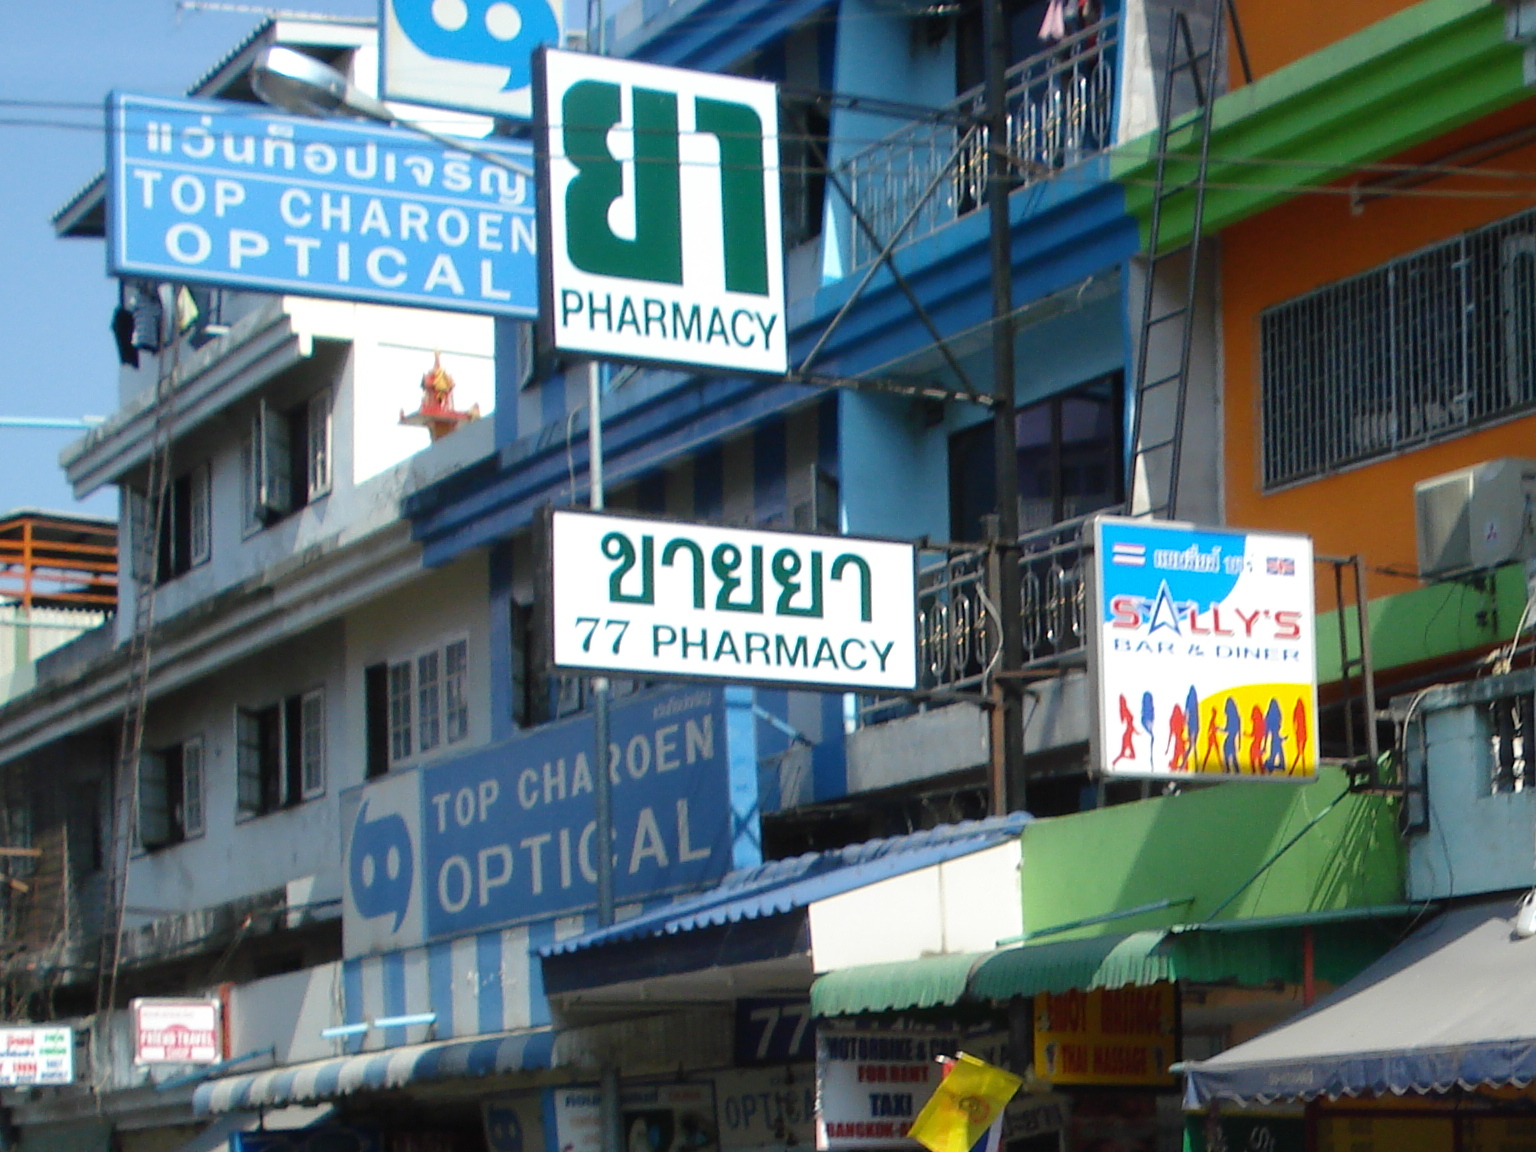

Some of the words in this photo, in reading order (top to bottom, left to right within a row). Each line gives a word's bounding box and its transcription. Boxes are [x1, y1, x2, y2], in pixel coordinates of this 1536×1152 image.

[134, 170, 246, 217] TOP
[280, 187, 537, 256] CHAROEN
[562, 79, 769, 297] ยา
[165, 222, 512, 301] OPTICAL
[561, 289, 778, 352] PHARMACY
[600, 530, 873, 622] ขายยา
[1112, 578, 1303, 640] SALLY'S
[575, 616, 630, 656] 77
[652, 624, 895, 672] PHARMACY
[1113, 638, 1174, 655] BAR
[1216, 644, 1300, 662] DINER
[432, 779, 500, 834] TOP
[438, 798, 711, 913] OPTICAL
[868, 1092, 913, 1117] TAXI
